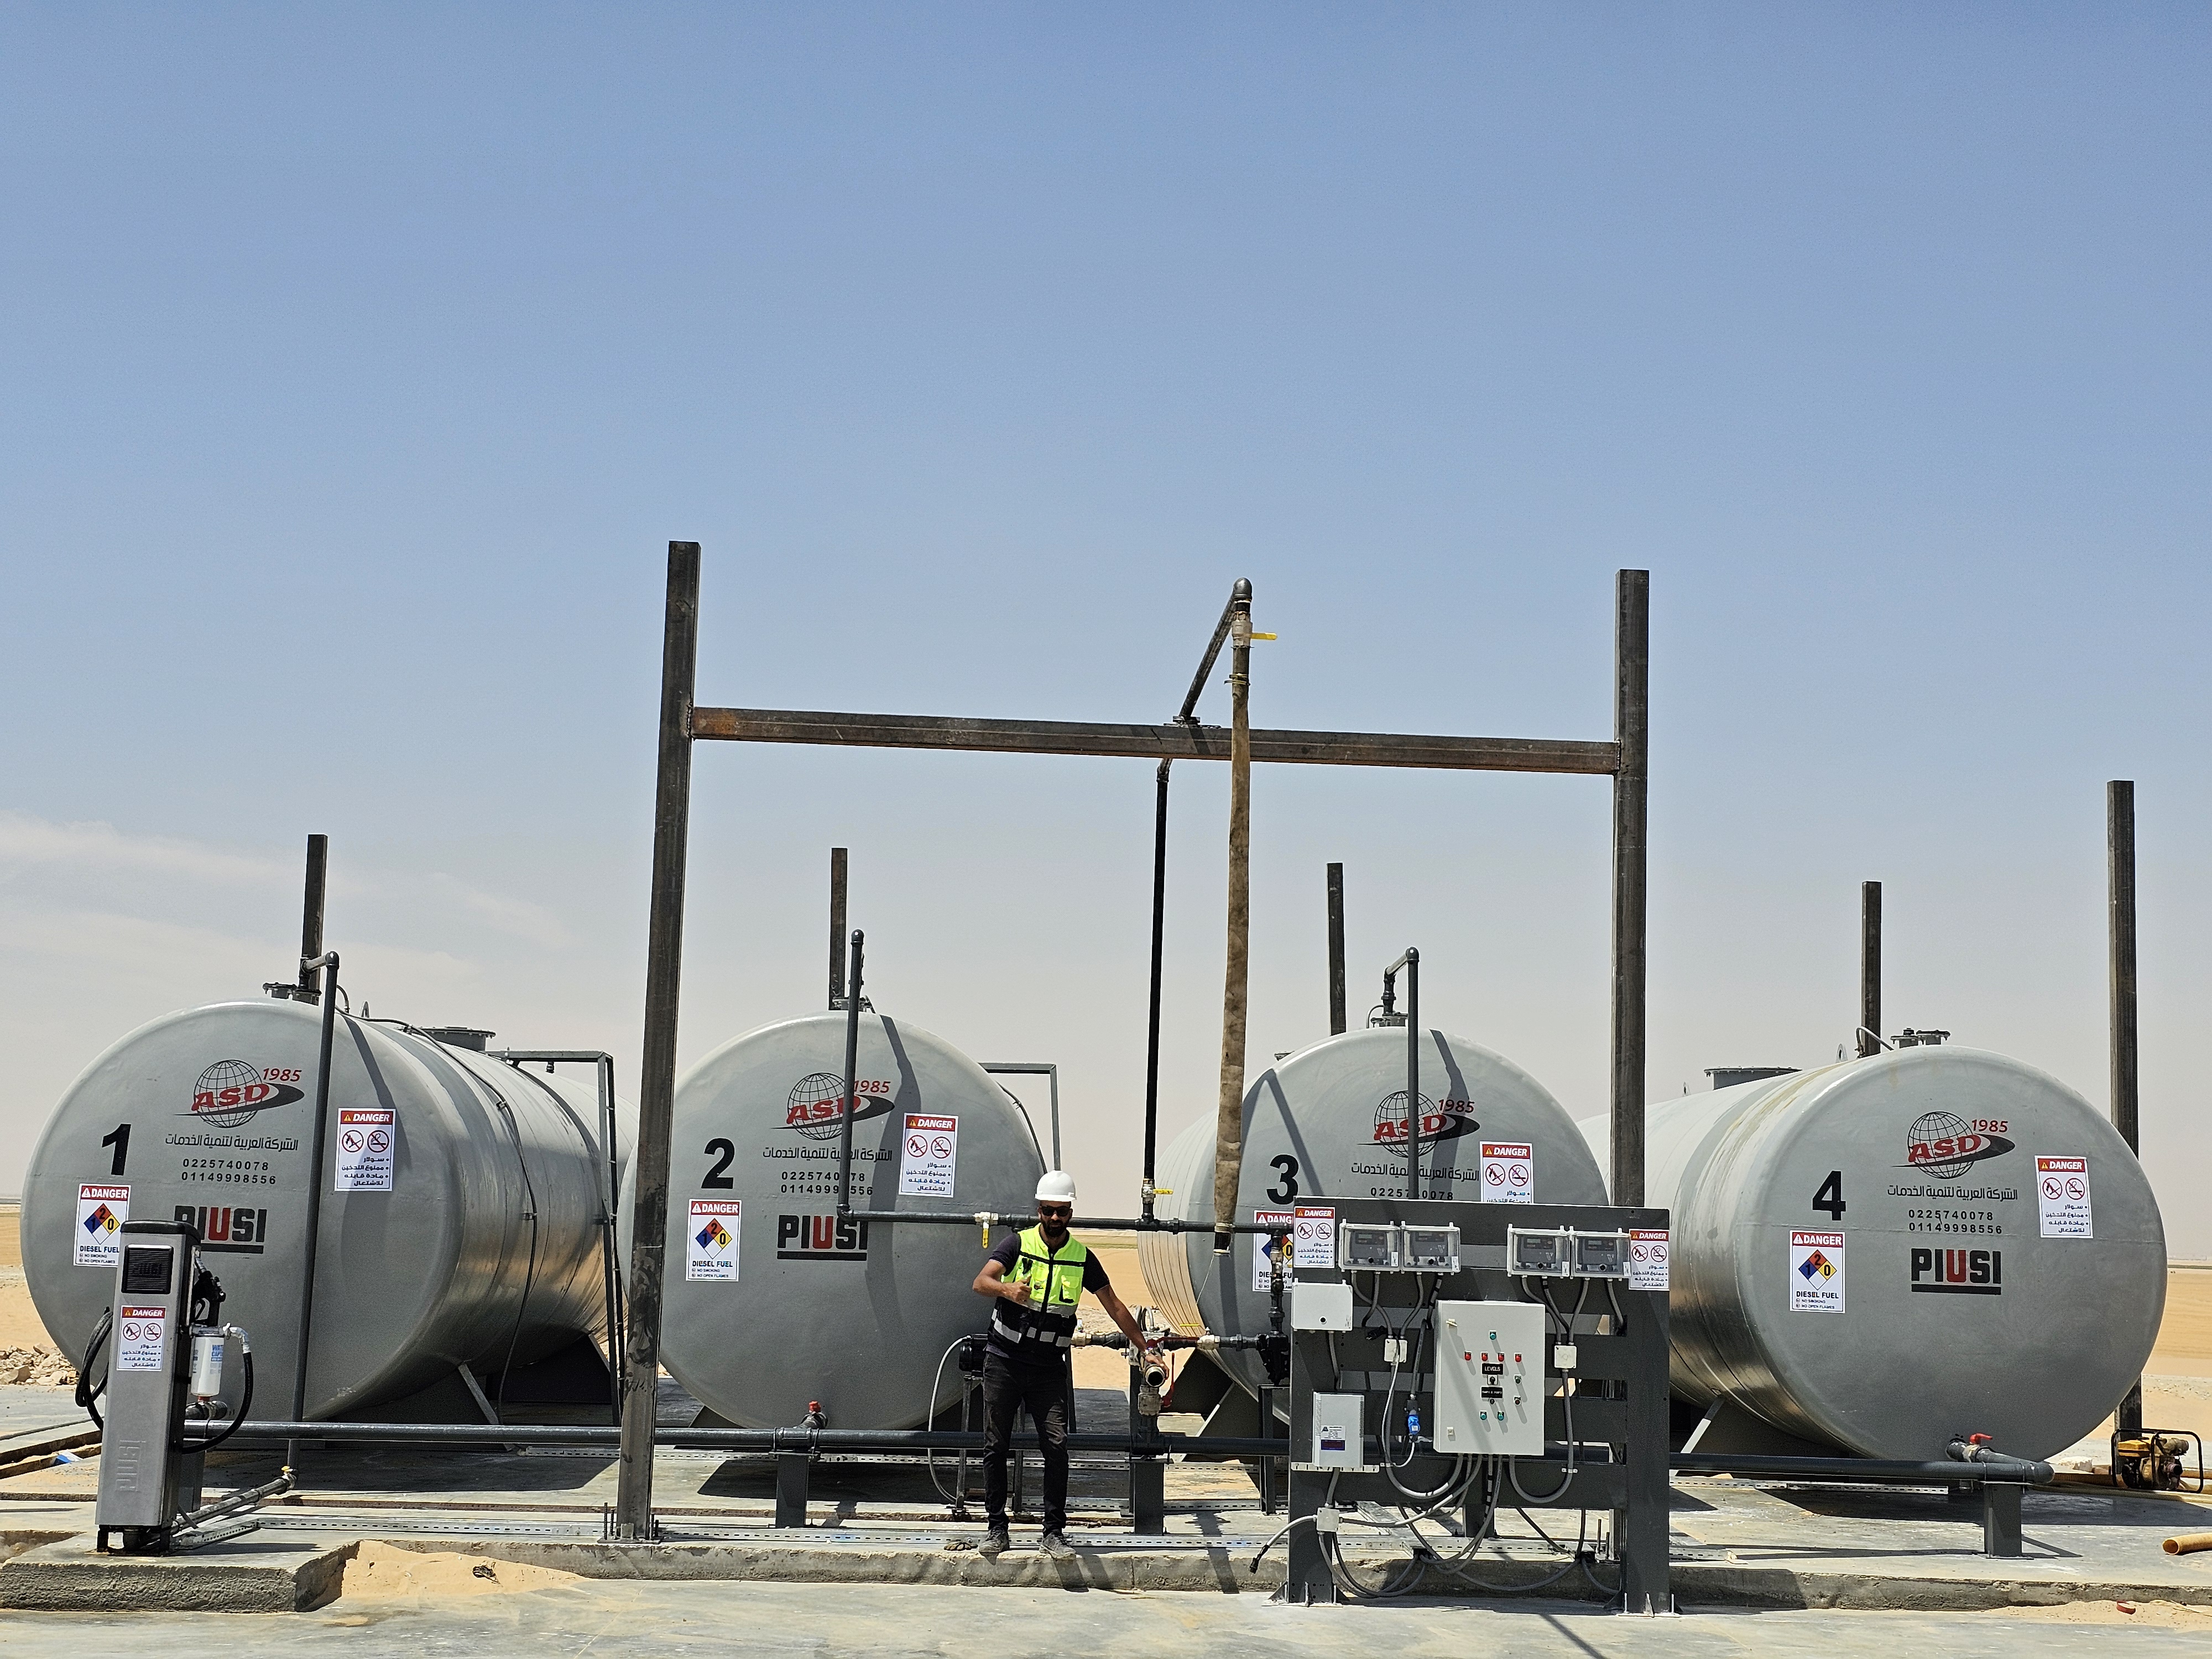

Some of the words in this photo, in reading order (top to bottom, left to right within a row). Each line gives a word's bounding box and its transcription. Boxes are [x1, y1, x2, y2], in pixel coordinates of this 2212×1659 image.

[263, 1068, 302, 1082] 1985
[854, 1080, 890, 1093] 1985
[191, 1084, 269, 1111] ASD
[786, 1095, 860, 1124] ASD
[1439, 1099, 1475, 1113] 1985
[917, 1119, 952, 1128] DANGER
[1972, 1119, 2008, 1133] 1985
[166, 1134, 201, 1146] الخدمات
[204, 1134, 232, 1149] لتنمية
[234, 1136, 263, 1150] العربية
[265, 1138, 298, 1152] الشركة
[102, 1124, 131, 1175] 1
[763, 1146, 799, 1159] الخدمات
[801, 1146, 828, 1161] لتنمية
[1494, 1147, 1527, 1156] DANGER
[1908, 1134, 1981, 1162] ASD
[860, 1149, 892, 1162] الشركة
[183, 1159, 268, 1170] 0225740078
[701, 1138, 735, 1189] 2
[1352, 1162, 1387, 1175] الخدمات
[2049, 1161, 2082, 1170] DANGER
[182, 1172, 275, 1184] 01149998556
[782, 1172, 865, 1181] 022574078
[1420, 1165, 1447, 1180] العربية
[1448, 1167, 1479, 1182] الشركة
[1266, 1154, 1298, 1205] 3
[91, 1189, 127, 1198] DANGER
[781, 1185, 873, 1195] 0114999556
[1371, 1188, 1453, 1200] 022570078
[1812, 1171, 1846, 1221] 4
[1888, 1185, 1924, 1197] الخدمات
[1926, 1185, 1954, 1199] لتنمية
[1957, 1186, 1985, 1201] العربية
[1986, 1187, 2017, 1202] الشركة
[100, 1208, 106, 1219] 2
[702, 1204, 738, 1213] DANGER
[1909, 1209, 1993, 1220] 0225740078
[91, 1218, 95, 1229] 1
[107, 1218, 114, 1230] 0
[1267, 1215, 1293, 1224] DANG
[711, 1223, 717, 1234] 2
[778, 1215, 868, 1250] PIUSI
[1910, 1223, 2002, 1234] 01149998556
[702, 1234, 707, 1244] 1
[719, 1233, 726, 1244] 0
[1804, 1235, 1841, 1245] DANGER
[1286, 1245, 1292, 1256] 0
[1814, 1254, 1820, 1265] 2
[1911, 1248, 2001, 1284] PIUSI
[1806, 1264, 1811, 1275] 1
[1824, 1265, 1830, 1276] 0
